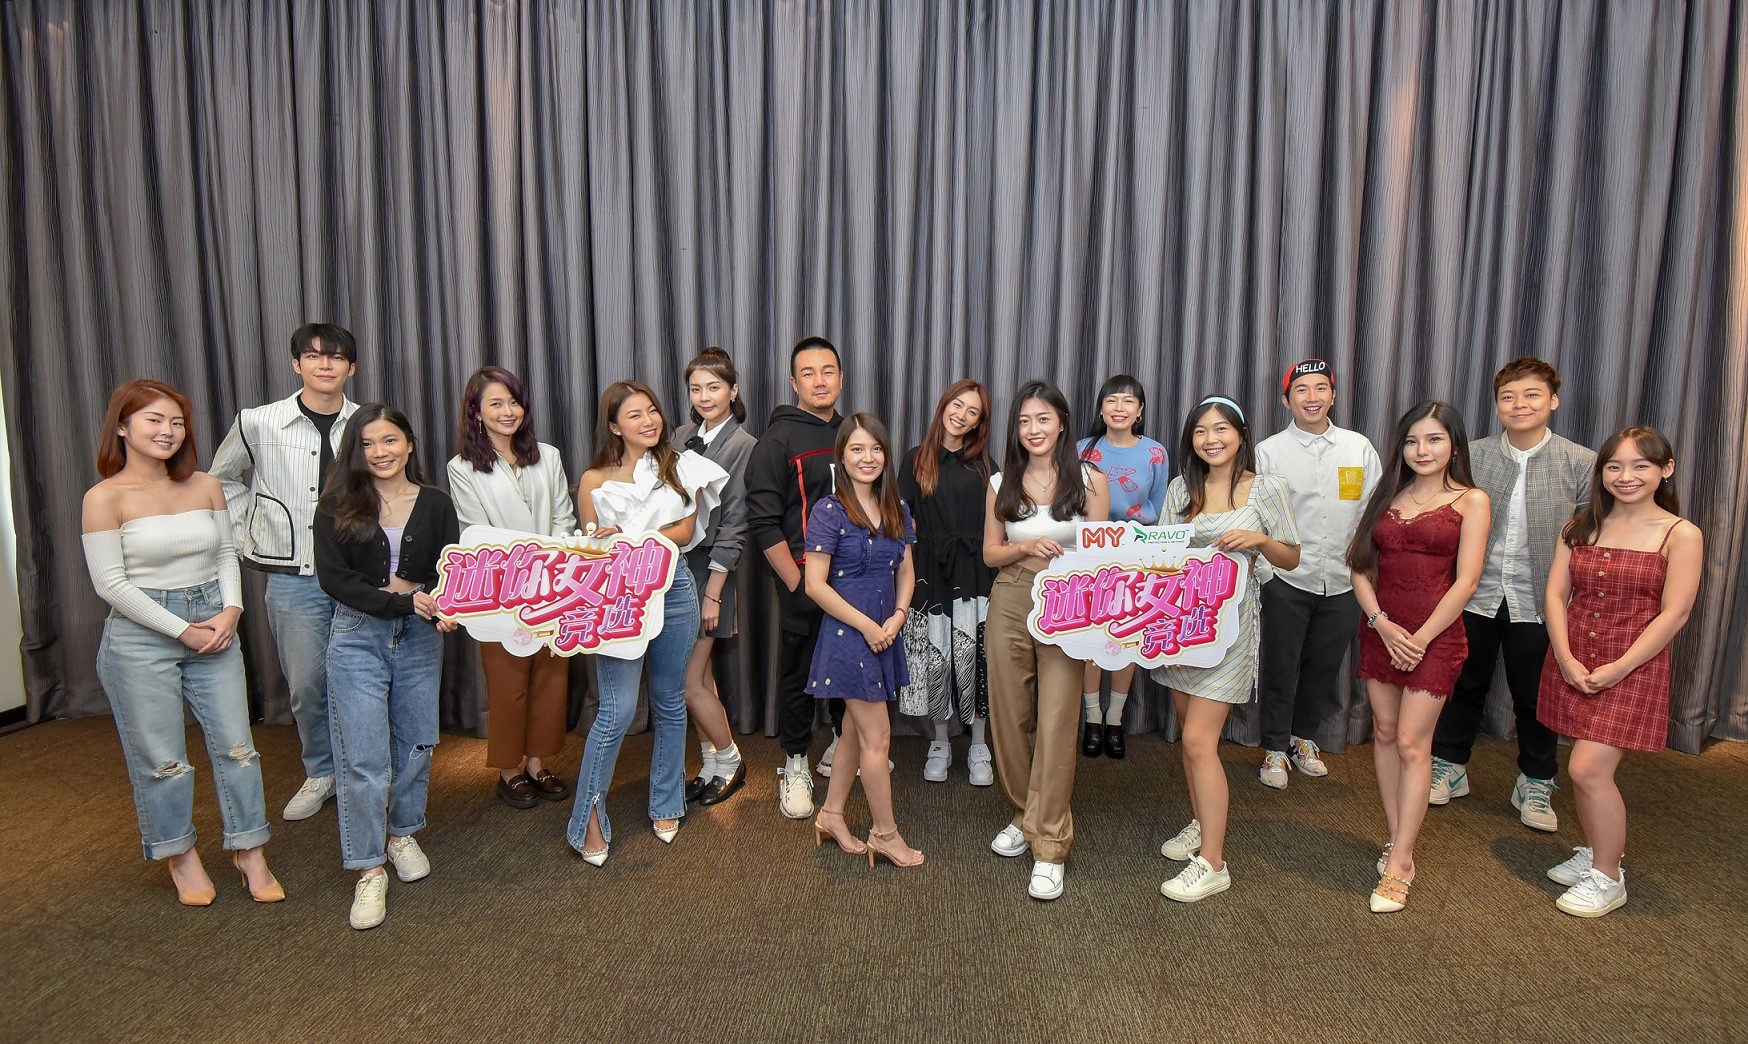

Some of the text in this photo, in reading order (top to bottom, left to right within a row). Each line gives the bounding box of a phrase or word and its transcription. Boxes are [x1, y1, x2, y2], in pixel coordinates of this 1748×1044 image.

[1295, 361, 1326, 373] HELLO
[1082, 526, 1125, 549] MY
[436, 537, 669, 624] 迷你女神
[1038, 554, 1235, 636] 迷你女神
[555, 594, 638, 646] 竞选
[1142, 605, 1214, 657] 竞选
